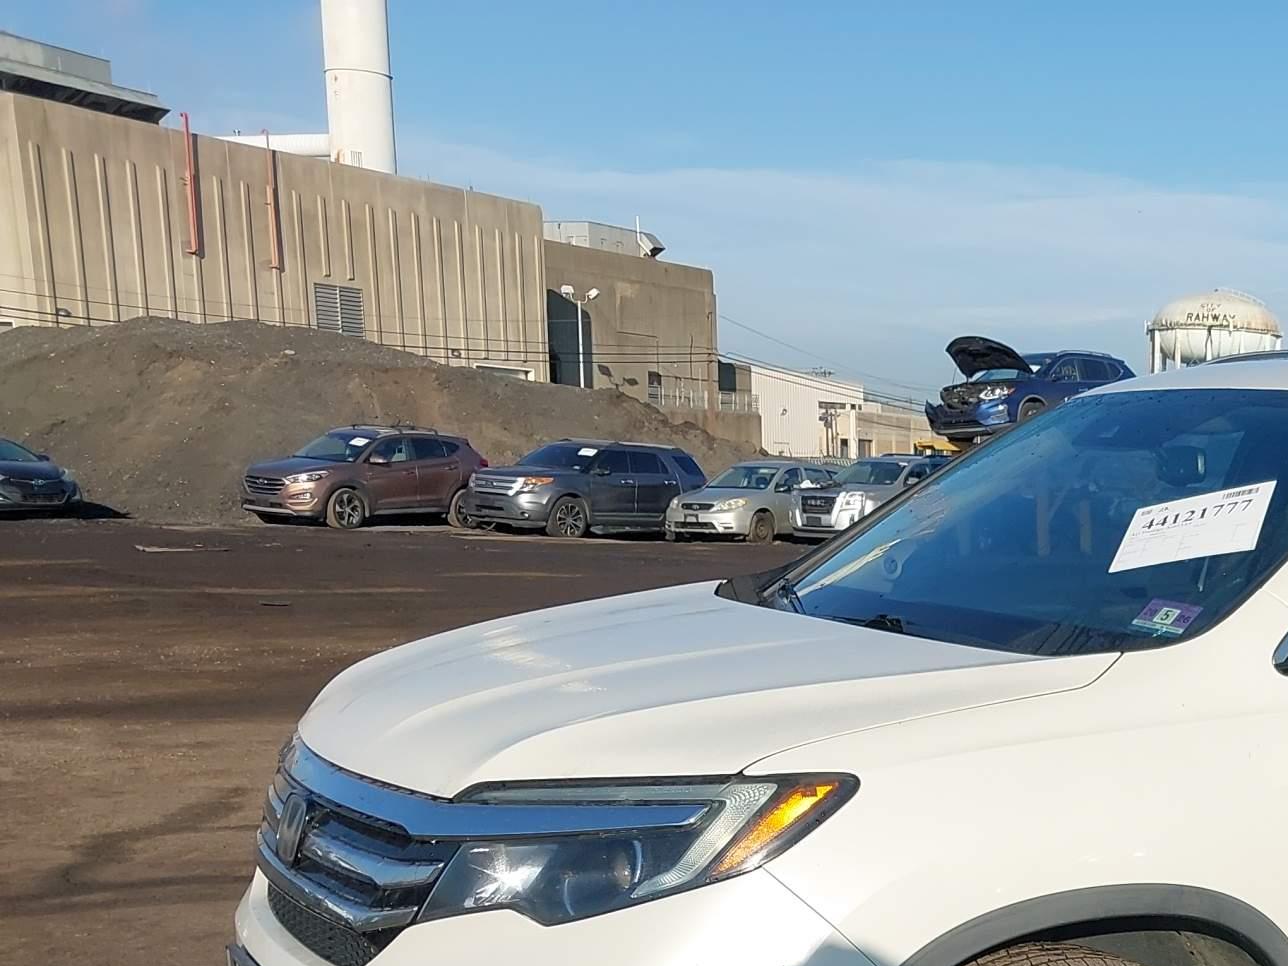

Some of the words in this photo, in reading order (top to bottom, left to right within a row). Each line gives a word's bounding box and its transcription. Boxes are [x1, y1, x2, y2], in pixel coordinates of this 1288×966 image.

[1186, 312, 1235, 322] RAHWAY
[1142, 499, 1254, 530] 44121777
[1160, 609, 1173, 621] 5
